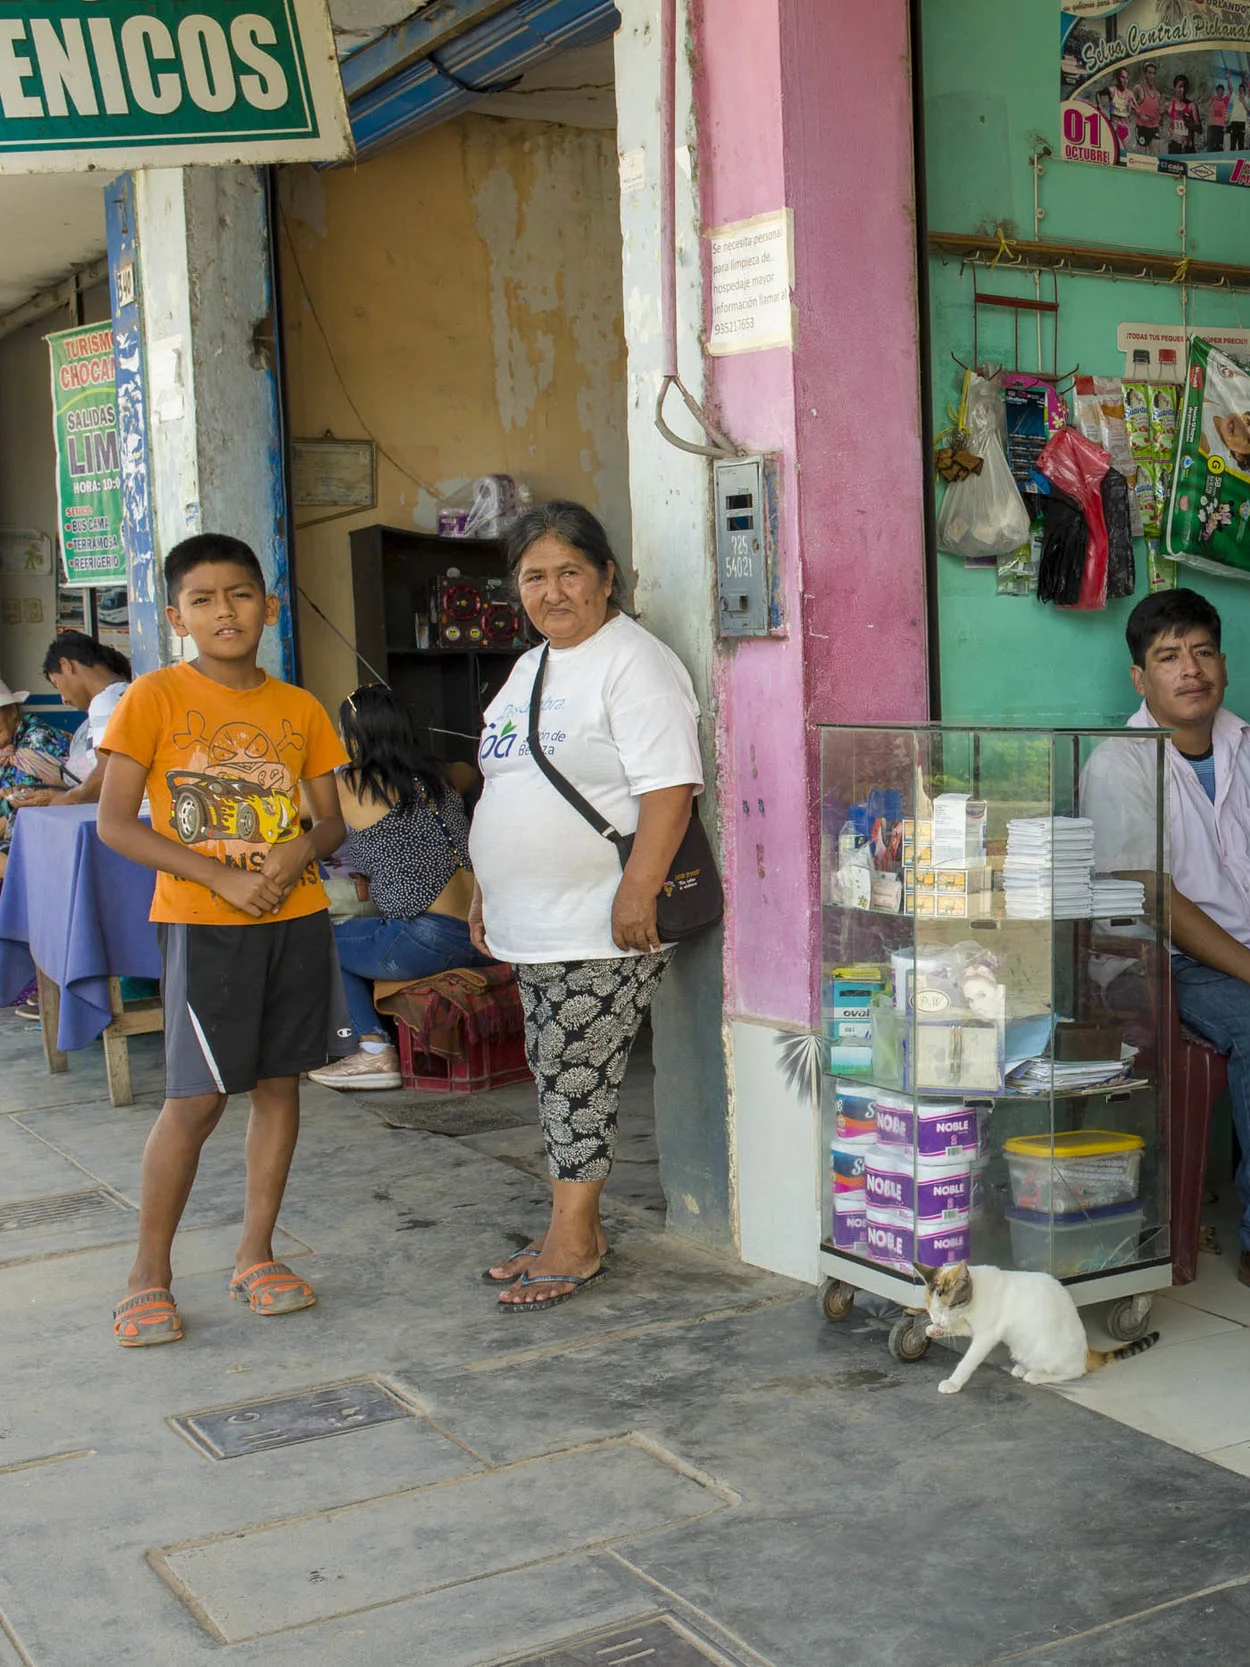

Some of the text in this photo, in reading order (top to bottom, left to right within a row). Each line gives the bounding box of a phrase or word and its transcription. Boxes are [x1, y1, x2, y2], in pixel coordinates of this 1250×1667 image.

[1082, 40, 1124, 74] Selva
[1128, 17, 1189, 55] Central
[0, 13, 288, 118] ENICOS
[1064, 108, 1100, 147] 01
[1065, 145, 1108, 164] OCTUBRE
[712, 228, 783, 255] Se necesita personal
[713, 251, 771, 275] para limpieza de
[68, 405, 115, 431] SALIDAS
[74, 480, 101, 494] HORA:
[73, 518, 108, 532] BUS CAMA
[74, 556, 119, 570] REFRIGERIO
[936, 1120, 969, 1133] NOBLE
[866, 1173, 902, 1200] NOBLE
[933, 1183, 964, 1197] NOBLE
[934, 1236, 964, 1250] NOBLE
